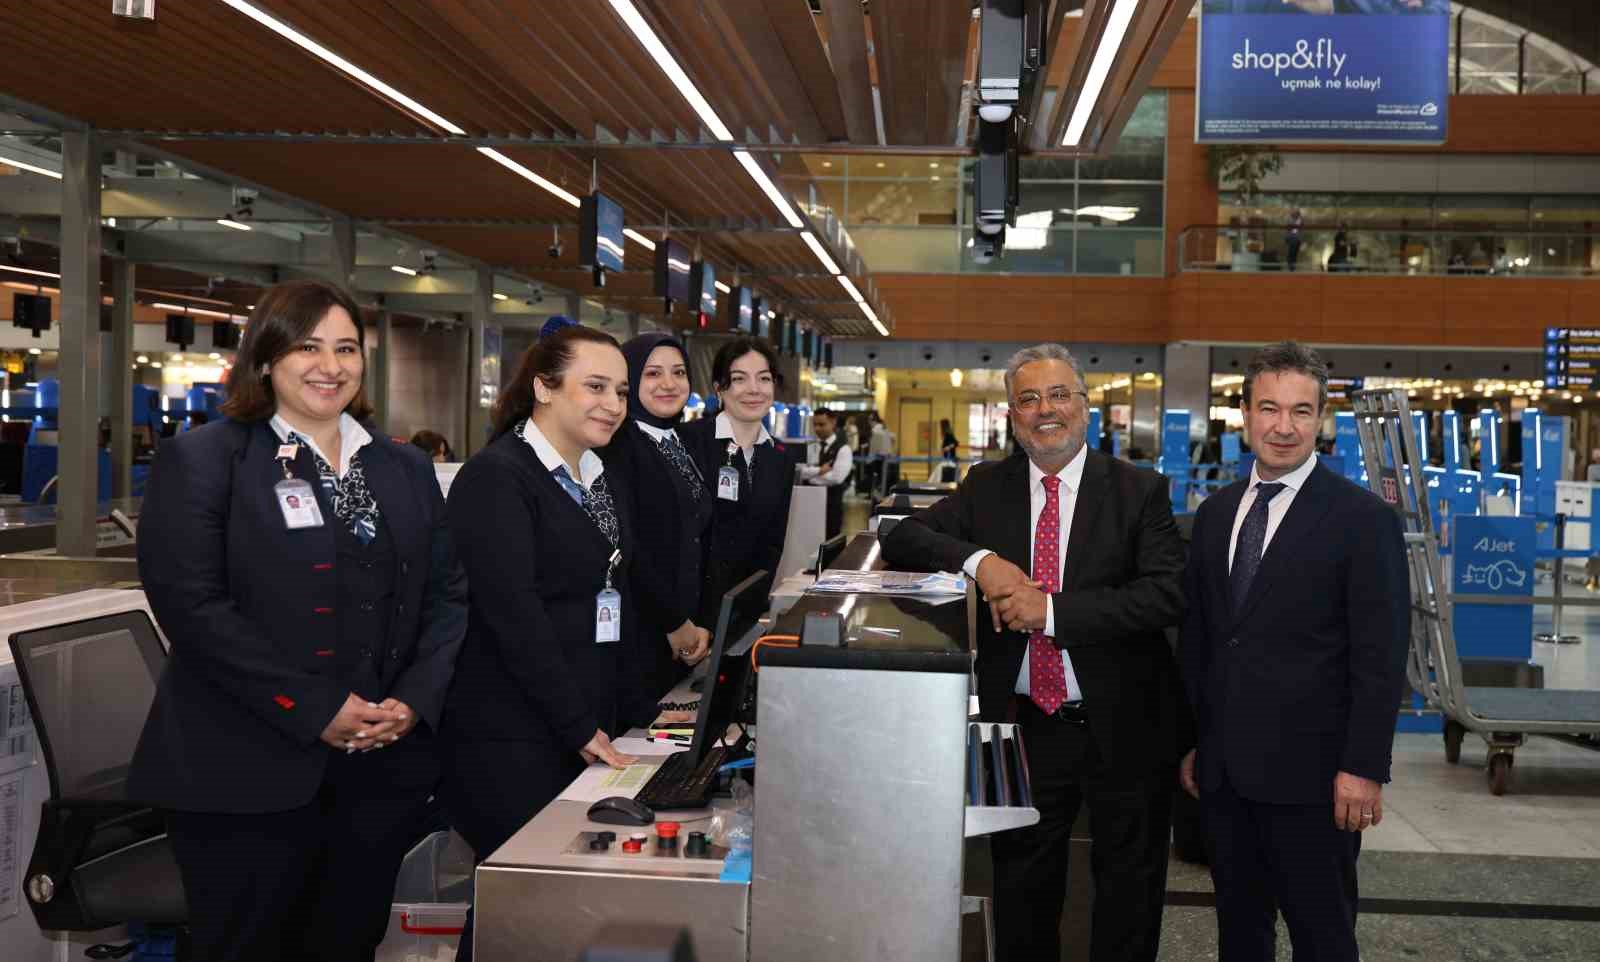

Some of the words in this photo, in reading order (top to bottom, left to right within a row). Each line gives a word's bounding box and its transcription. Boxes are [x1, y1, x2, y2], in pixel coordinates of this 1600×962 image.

[1231, 38, 1347, 77] shop&fly
[1281, 75, 1322, 92] uçmak
[1326, 79, 1342, 89] ne
[1345, 75, 1381, 92] kolay!
